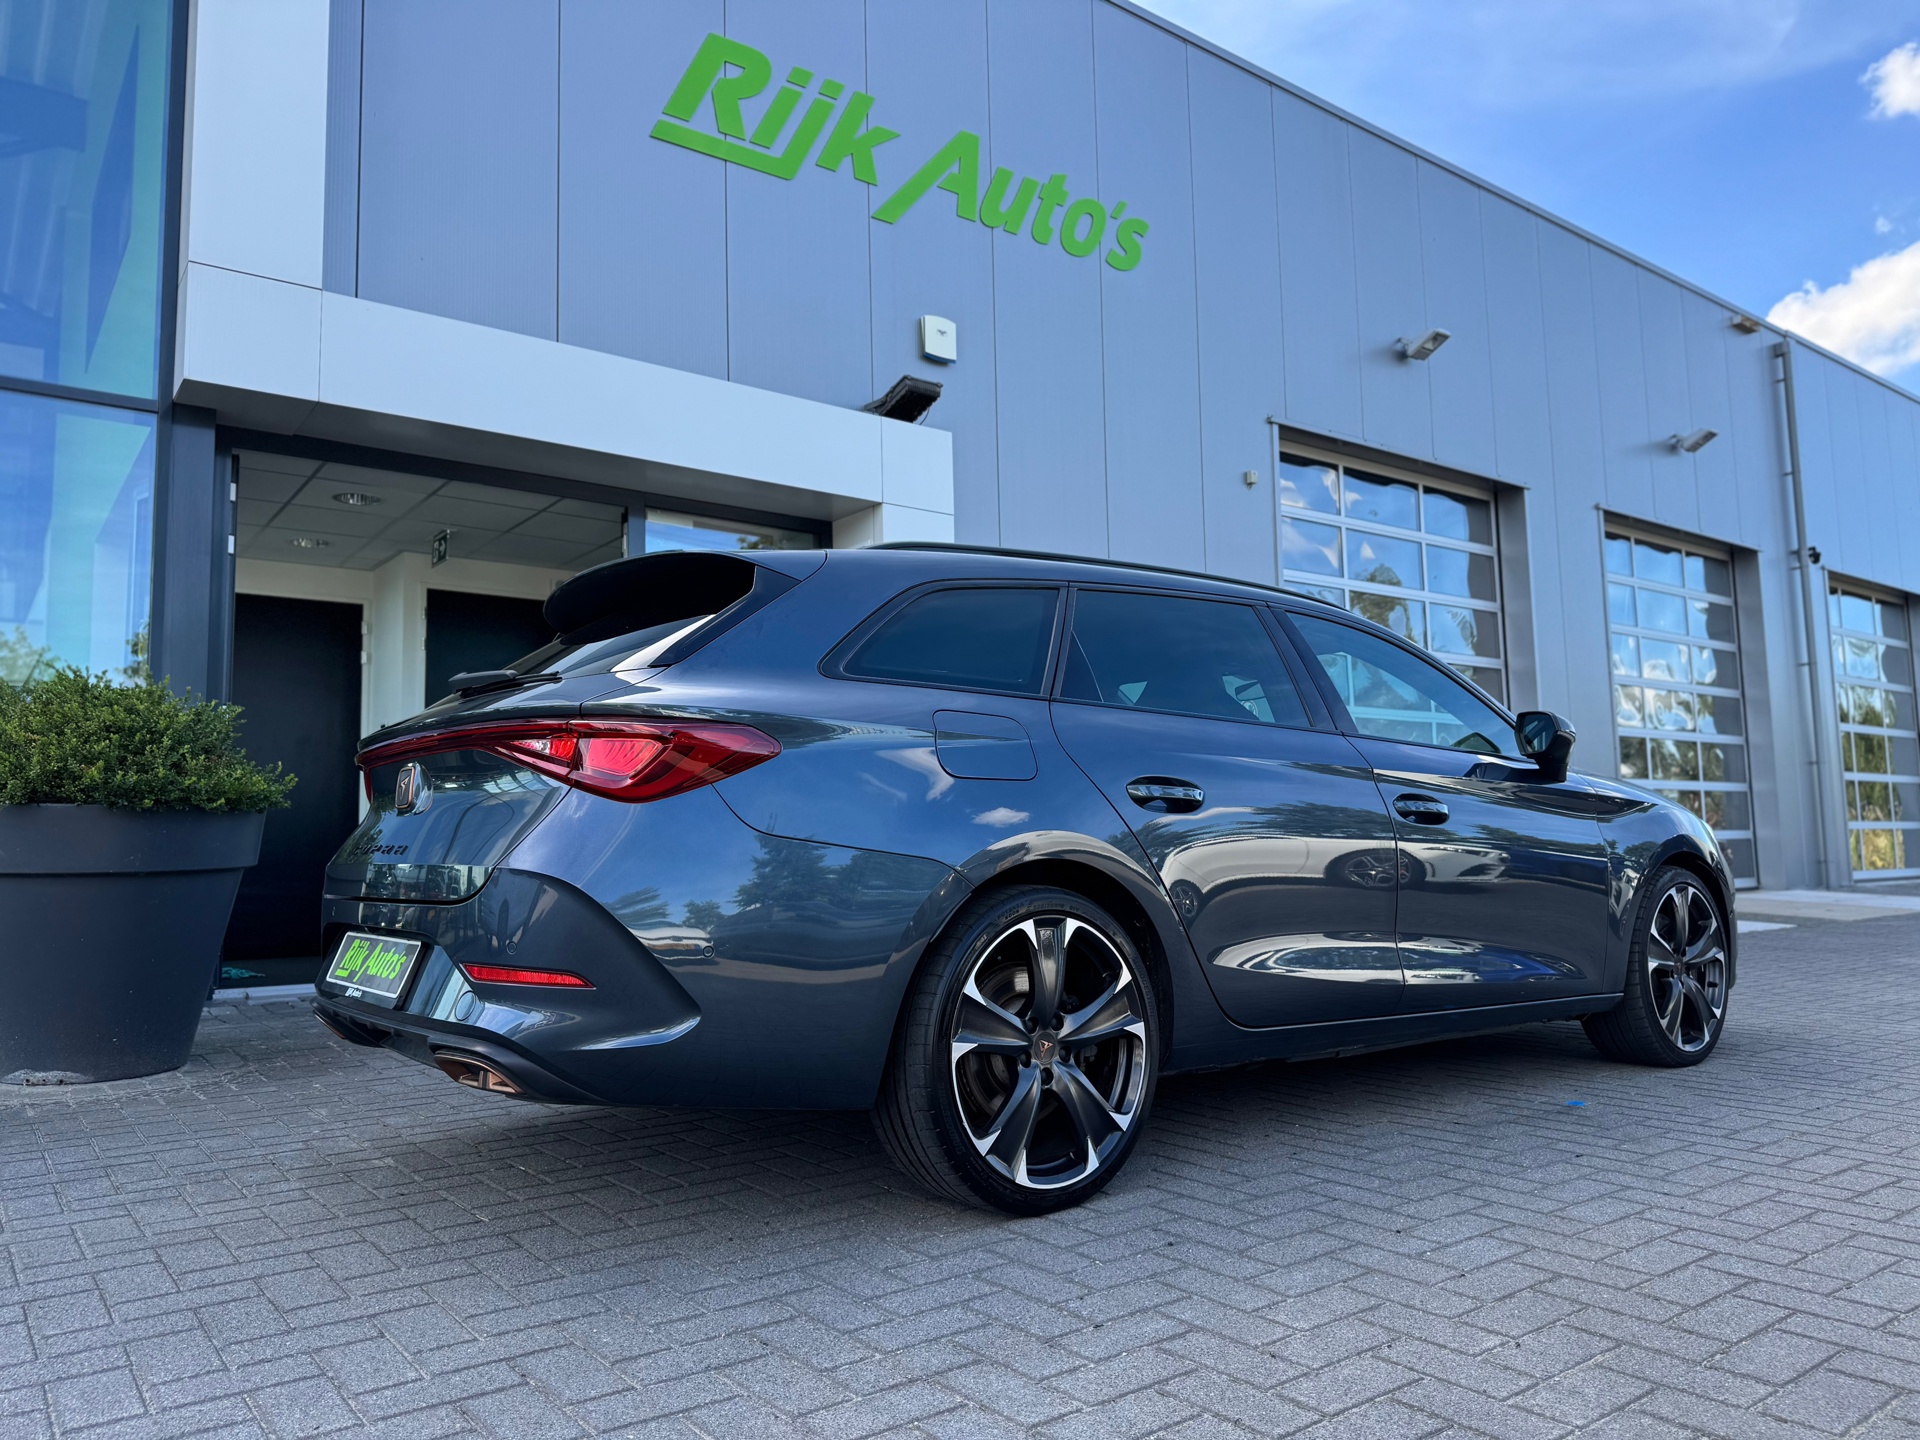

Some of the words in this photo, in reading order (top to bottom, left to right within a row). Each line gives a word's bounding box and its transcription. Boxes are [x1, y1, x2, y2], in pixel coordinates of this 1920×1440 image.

[649, 32, 901, 187] Rijk
[871, 130, 1150, 272] Auto's
[335, 939, 369, 977] Rijk
[352, 942, 407, 982] Auto's
